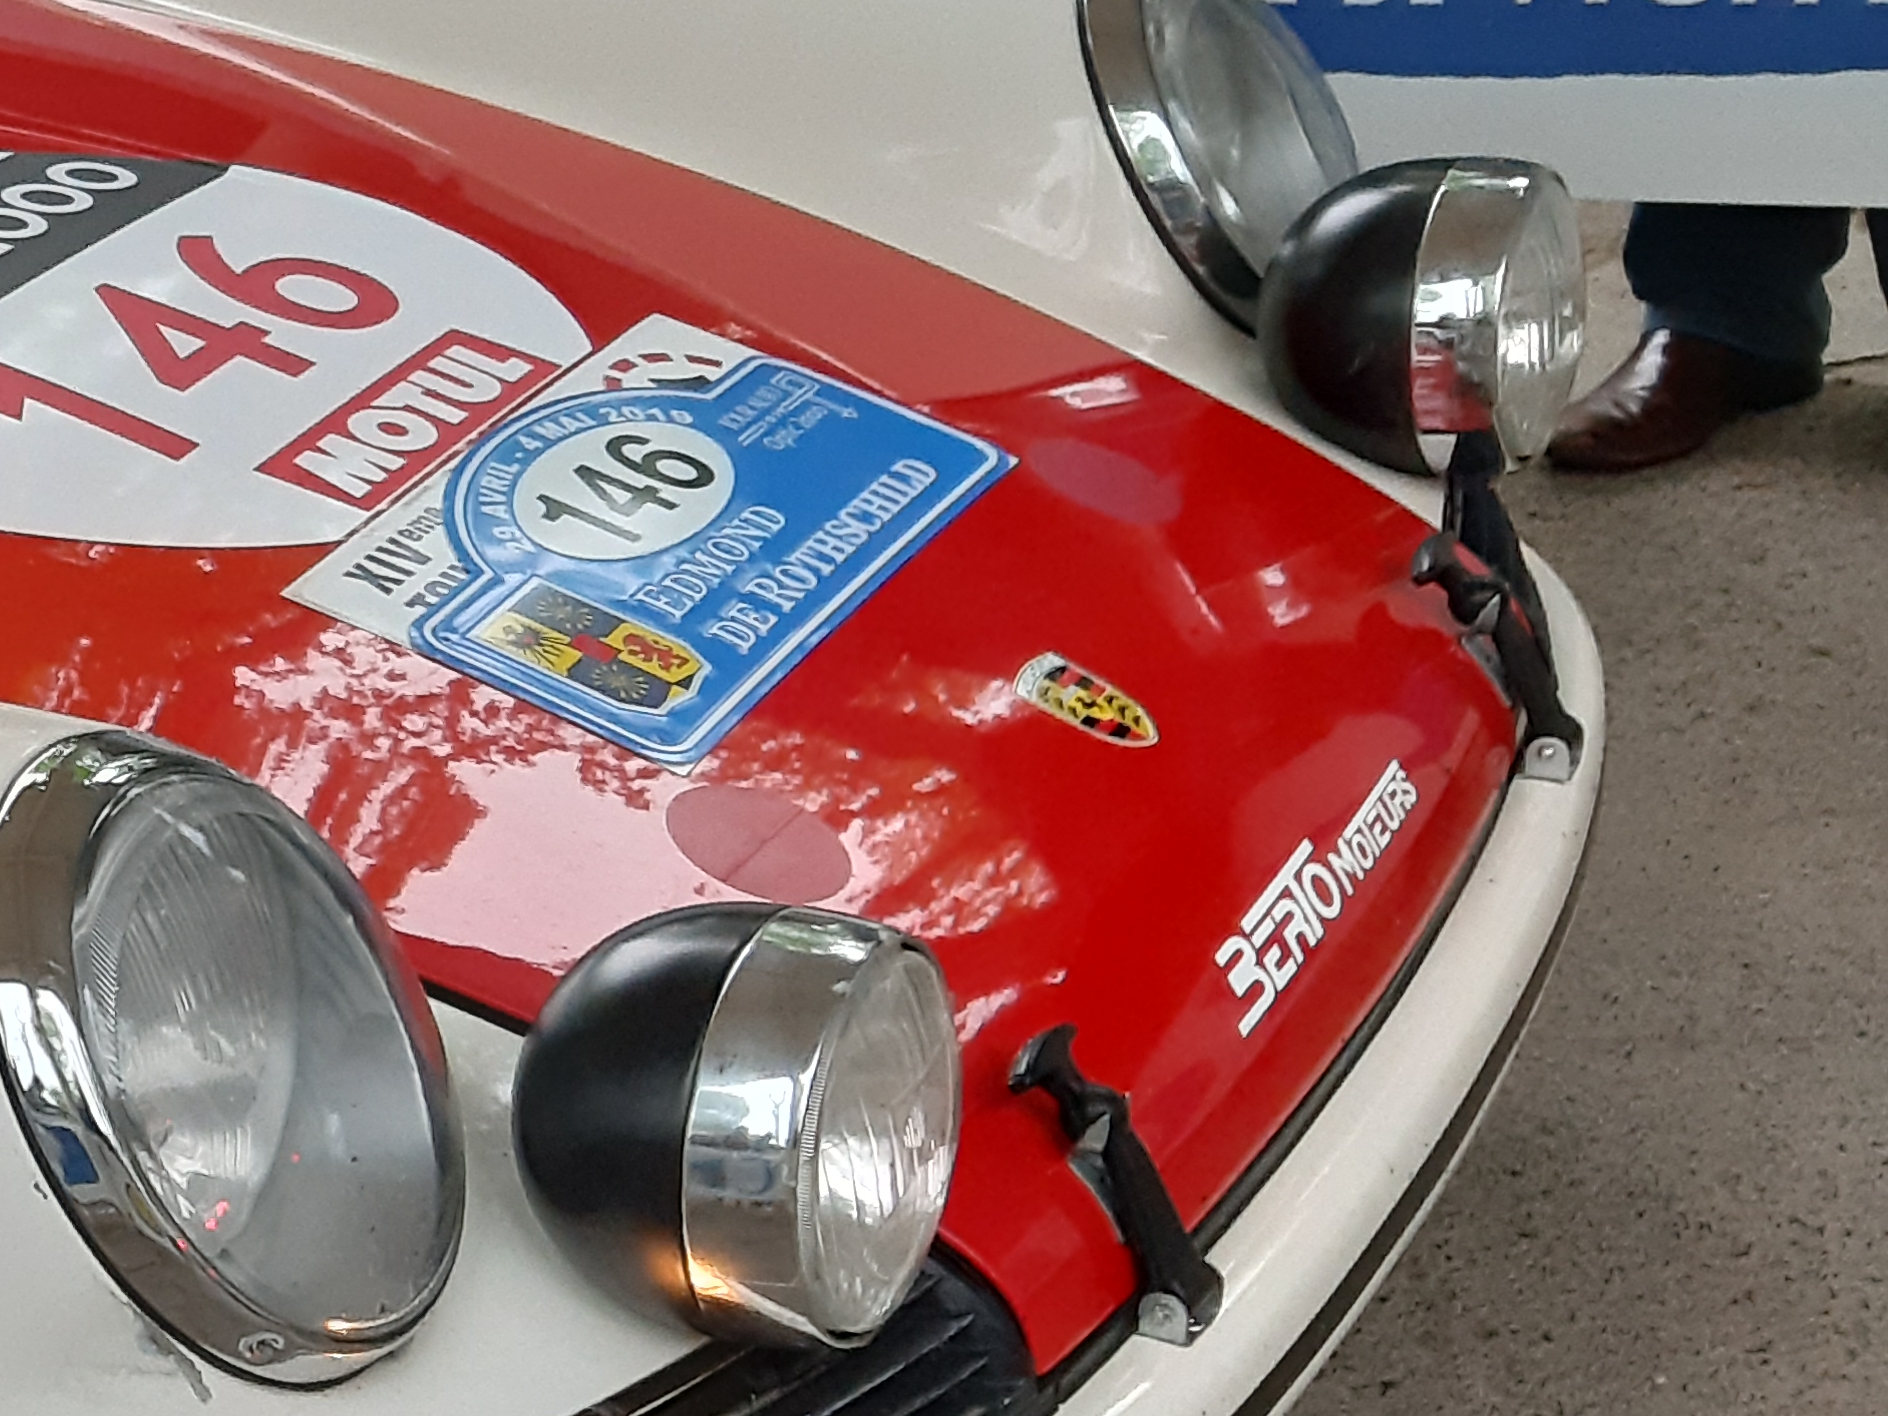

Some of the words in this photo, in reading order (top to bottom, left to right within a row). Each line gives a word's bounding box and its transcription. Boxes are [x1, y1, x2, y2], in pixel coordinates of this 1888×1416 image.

[292, 344, 535, 499] MOTUL
[478, 462, 521, 520] AVRIL
[517, 435, 544, 452] 4
[533, 411, 597, 441] MAI
[535, 434, 716, 543] 146
[626, 504, 787, 621] EDMOND
[706, 600, 780, 655] DE
[743, 457, 939, 615] ROTHSCHILD
